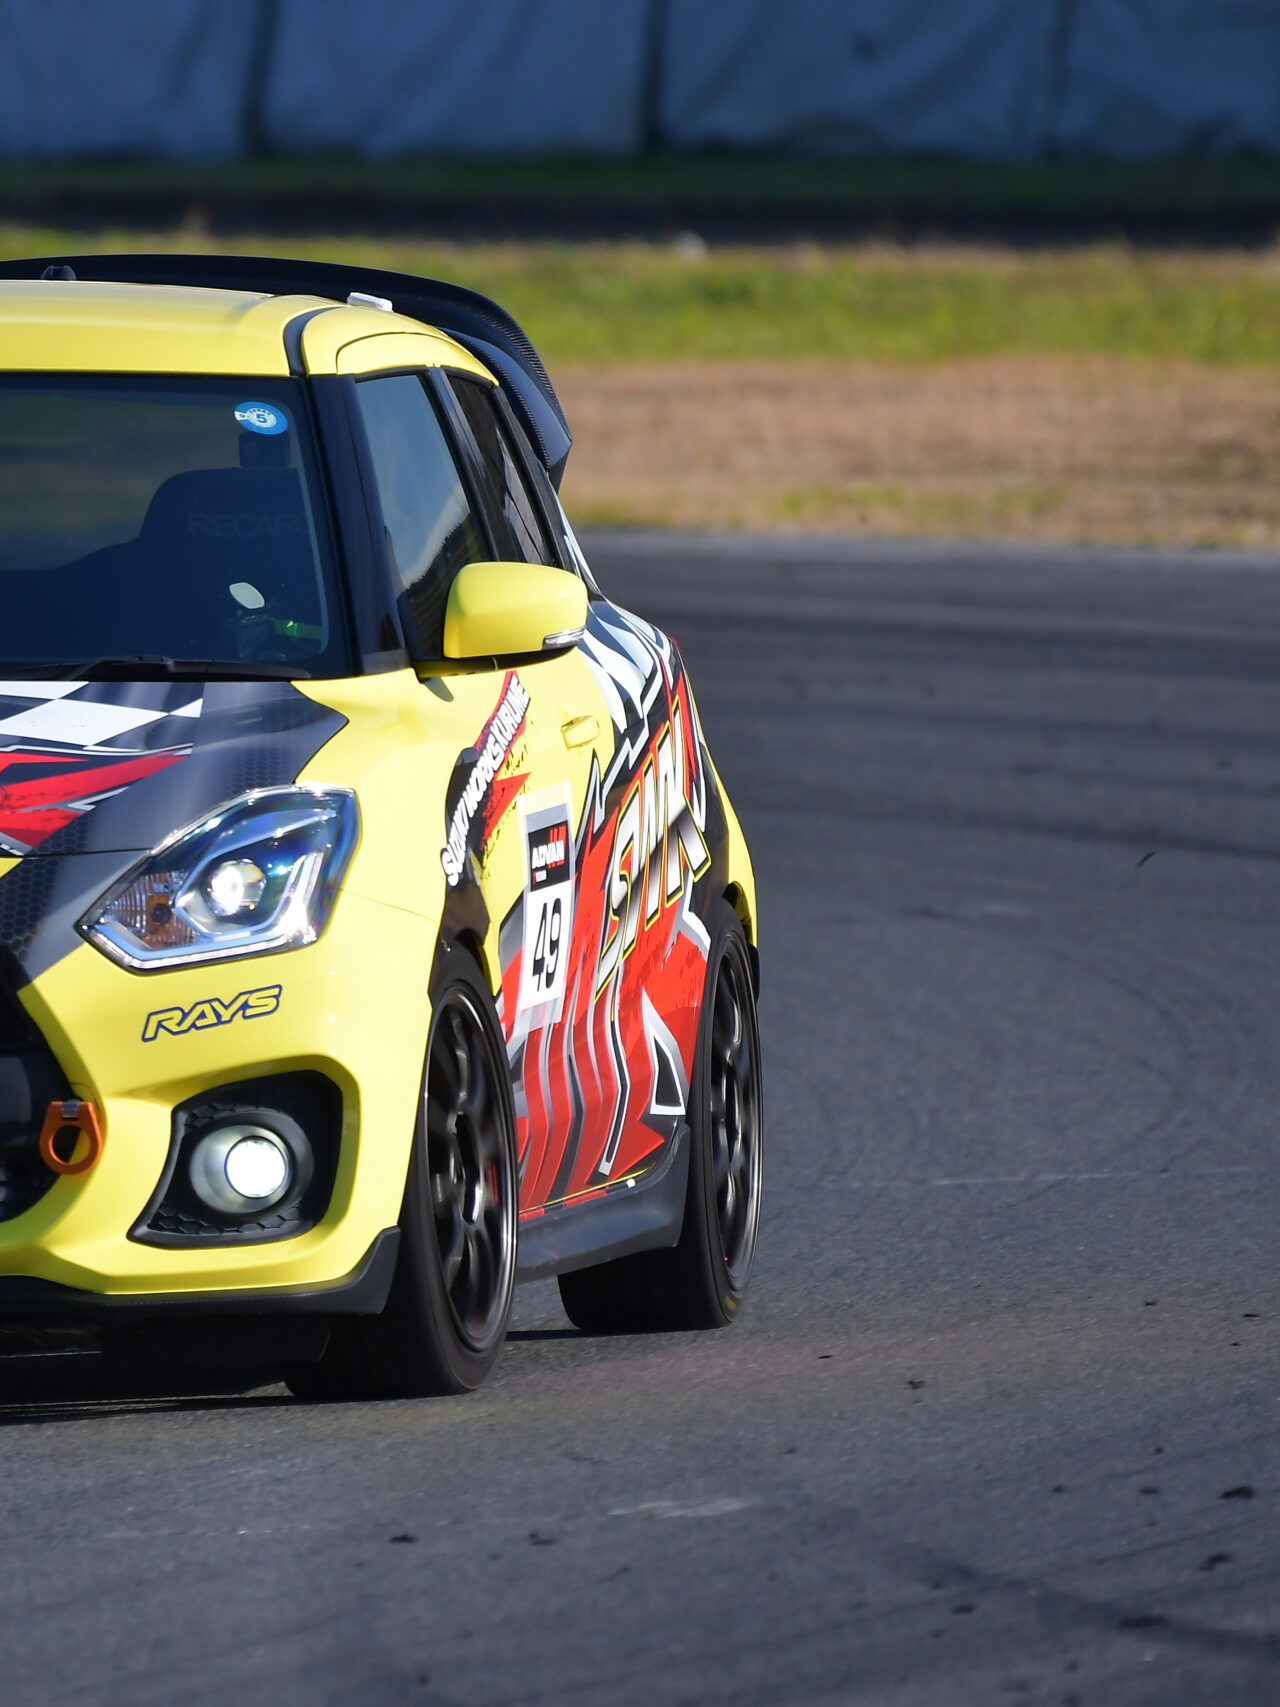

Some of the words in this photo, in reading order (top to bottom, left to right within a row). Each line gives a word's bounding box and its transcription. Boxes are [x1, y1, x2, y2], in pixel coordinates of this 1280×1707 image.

[256, 413, 268, 424] 5
[531, 839, 565, 869] ADVAN
[532, 897, 562, 992] 49
[141, 984, 282, 1042] RAYS
